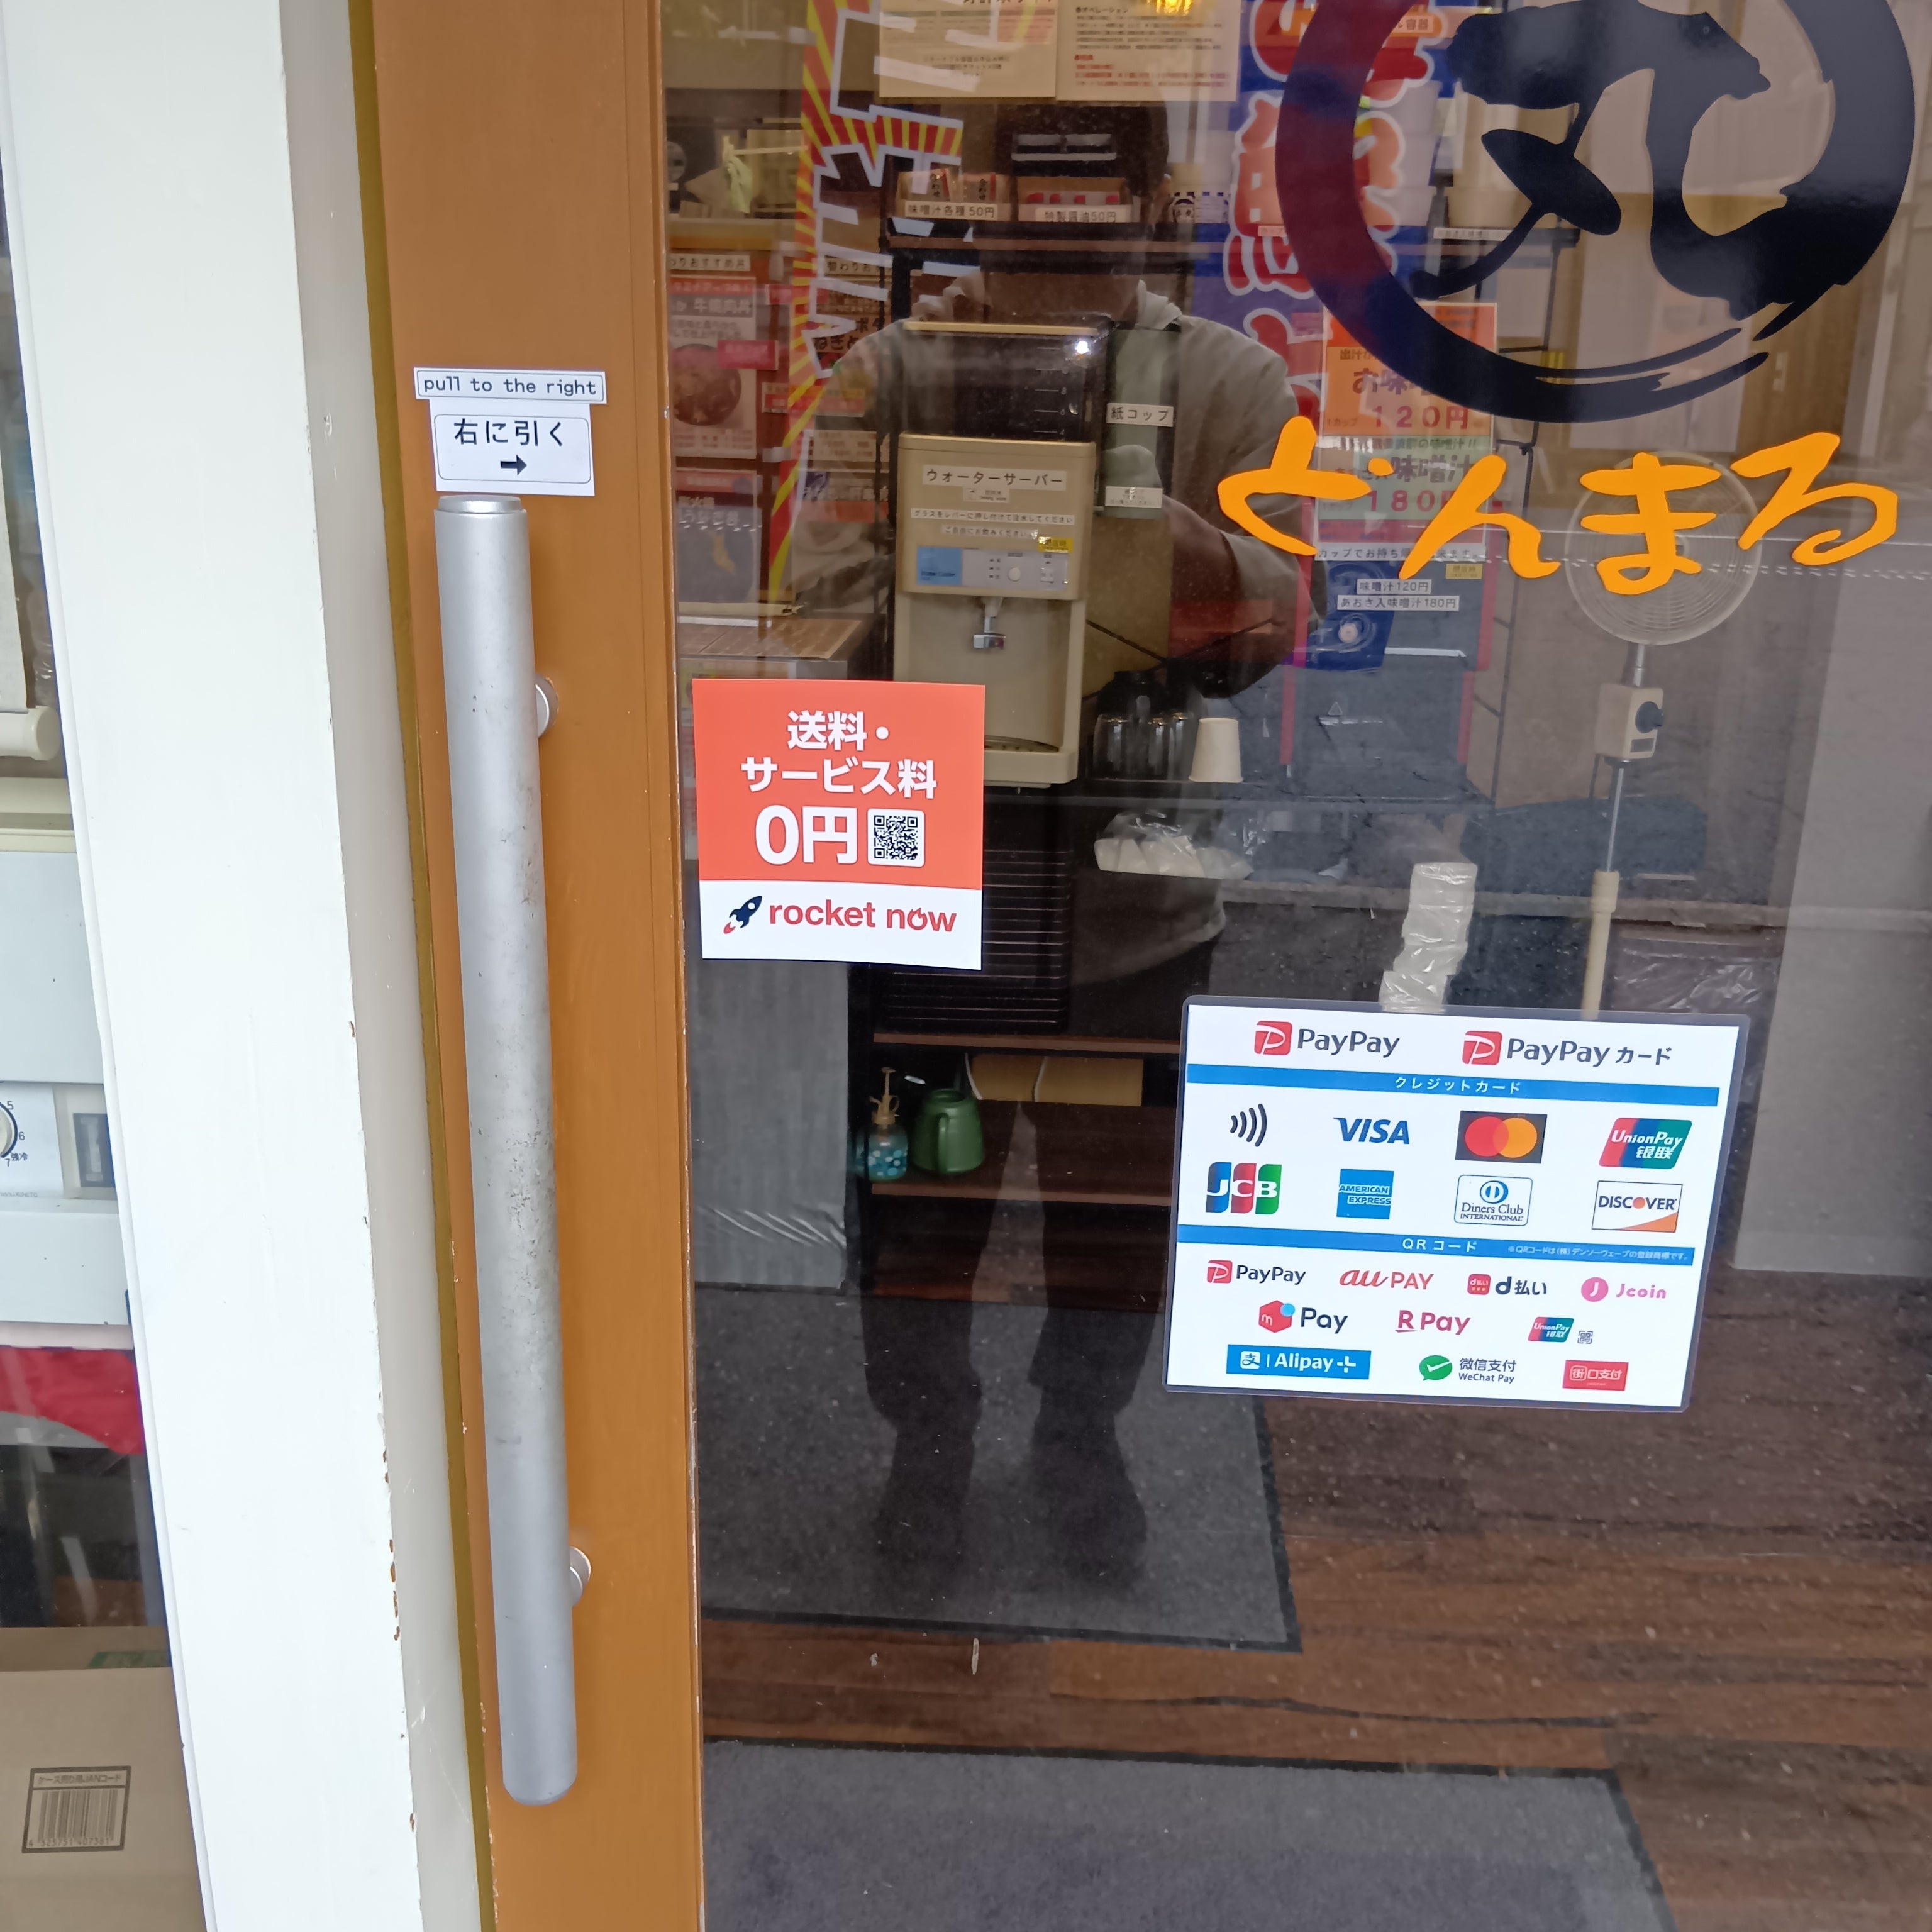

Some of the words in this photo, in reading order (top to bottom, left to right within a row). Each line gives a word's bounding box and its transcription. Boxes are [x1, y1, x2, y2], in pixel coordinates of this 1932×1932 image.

[424, 375, 460, 392] pull
[470, 378, 492, 392] to
[504, 378, 536, 393] the
[547, 379, 597, 397] right
[1111, 406, 1169, 422] 紙コップ
[453, 418, 564, 447] 右に引く
[926, 469, 1063, 486] ウォーターサーバー
[1218, 416, 1898, 595] どんまる
[1359, 581, 1429, 592] 味噌汁120円
[1340, 597, 1457, 609] あおさ入味噌汁180円
[740, 756, 938, 799] サービス料
[755, 804, 858, 865] 0円
[769, 899, 877, 928] rocket
[886, 907, 958, 932] now
[1297, 1028, 1401, 1058] PayPay
[1507, 1038, 1611, 1068] PayPay
[1616, 1046, 1672, 1065] カード
[1395, 1076, 1521, 1094] クレジットカード
[7, 1101, 14, 1111] 5
[19, 1131, 25, 1141] 6
[1333, 1117, 1410, 1145] VISA
[1611, 1130, 1684, 1150] UnionPay
[1206, 1179, 1279, 1199] JCB
[1339, 1184, 1389, 1194] AMERICAN
[1347, 1196, 1392, 1206] EXPRESS
[1461, 1202, 1496, 1214] Diners
[1498, 1204, 1524, 1215] Club
[1598, 1196, 1678, 1211] DISCOVER
[1460, 1213, 1524, 1222] INTERNATIONAL
[1236, 1265, 1306, 1285] PayPay
[1339, 1269, 1389, 1287] au
[1391, 1272, 1435, 1290] PAY
[1495, 1276, 1548, 1296] d払い
[1616, 1283, 1667, 1299] Jcoin
[1301, 1307, 1348, 1334] Pay
[1396, 1309, 1419, 1333] R
[1420, 1312, 1472, 1336] Pay
[1533, 1322, 1570, 1336] UnionPay
[1459, 1357, 1517, 1373] 微信支付
[1458, 1373, 1495, 1382] WeChat
[1497, 1375, 1515, 1384] Pay
